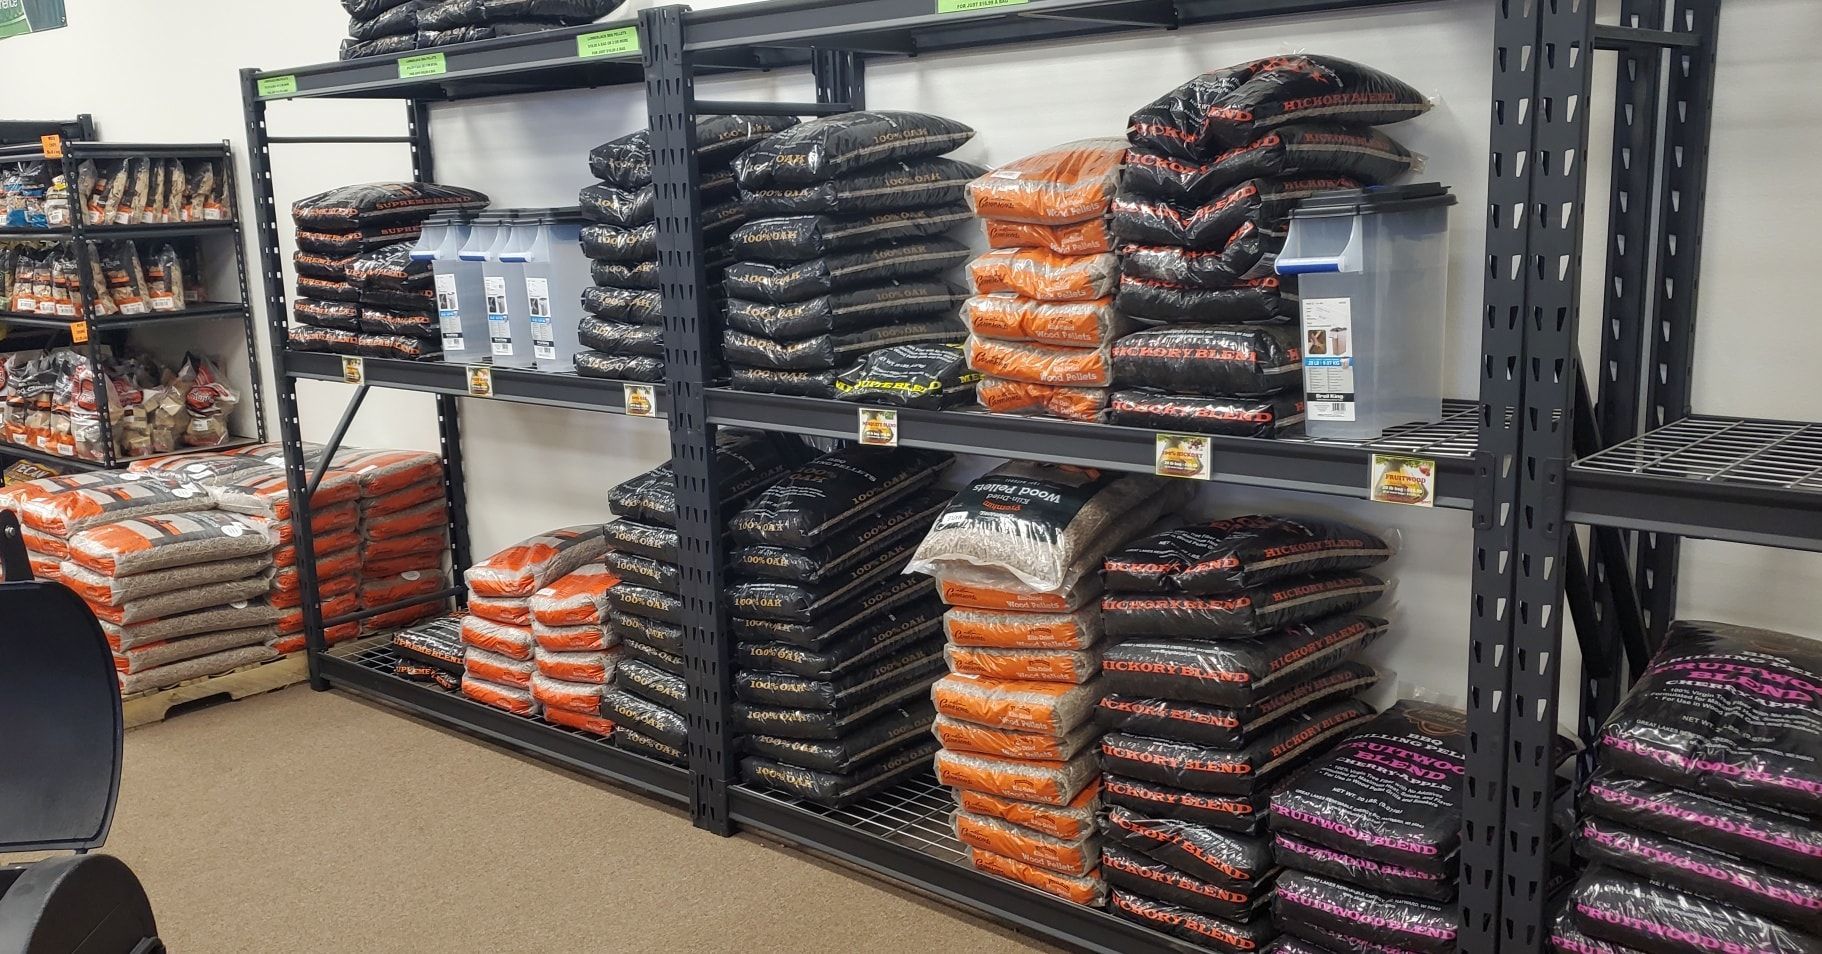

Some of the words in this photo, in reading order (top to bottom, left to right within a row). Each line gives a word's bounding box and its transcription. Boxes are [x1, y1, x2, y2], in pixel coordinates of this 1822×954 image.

[1282, 93, 1348, 111] HICKORY
[776, 154, 808, 166] OAK
[375, 197, 433, 211] SUPREME
[903, 288, 928, 297] OAK
[903, 325, 928, 334] OAK
[1066, 372, 1097, 381] Pellets
[834, 463, 878, 483] PELLETS
[1385, 474, 1426, 484] FRUITWOOD
[851, 487, 883, 505] 100%
[972, 483, 1018, 495] Pellets
[1018, 486, 1060, 504] Wood
[857, 525, 888, 543] 100%
[888, 508, 915, 526] OAK
[639, 537, 663, 549] OAK
[1263, 540, 1323, 559] HICKORY
[1323, 537, 1363, 550] BLEND
[765, 555, 788, 567] OAK
[639, 566, 662, 580] OAK
[862, 591, 891, 608] 100%
[891, 576, 917, 593] OAK
[1272, 583, 1322, 602] HICKORY
[620, 593, 646, 607] 100%
[646, 598, 670, 611] OAK
[760, 597, 783, 608] OAK
[1031, 601, 1060, 610] Pellets
[394, 637, 432, 656] UPREME
[750, 647, 777, 657] 100%
[1269, 640, 1326, 672] HICKORY
[1325, 621, 1367, 647] BLEND
[1741, 650, 1791, 663] BBQ
[396, 666, 432, 675] UPREME
[1102, 660, 1178, 675] HICKORY
[1181, 665, 1250, 684] BLEND
[1687, 671, 1814, 702] BLEND
[1692, 690, 1715, 699] Virgin
[1650, 691, 1693, 701] Formulated
[1694, 694, 1706, 702] for
[1676, 697, 1692, 705] Use
[1702, 702, 1724, 716] Wood
[614, 703, 640, 721] 100%
[640, 715, 666, 732] OAK
[1171, 709, 1240, 729] BLEND
[1636, 719, 1656, 728] GREAT
[1657, 724, 1679, 734] LAKES
[1682, 715, 1699, 724] NET
[1701, 719, 1714, 728] WT.
[1272, 722, 1323, 757] HICKORY
[1322, 709, 1358, 731] BLEND
[1352, 733, 1423, 748] RILLING
[1407, 733, 1444, 746] BBQ
[654, 743, 681, 758] OAK
[1102, 744, 1180, 769] HICKORY
[1185, 760, 1252, 775] BLEND
[1350, 741, 1465, 775] RUITWOO
[1336, 757, 1453, 792] CHERRY-APPLE
[1354, 750, 1446, 781] BLEND
[1104, 781, 1178, 804] HICKORY
[1180, 795, 1253, 814] BLEND
[1589, 783, 1736, 834] FRUITWOOD
[1270, 801, 1372, 843] FRUITWOOD
[1372, 836, 1438, 856] BLEND
[1021, 852, 1045, 865] Wood
[1181, 838, 1250, 881] BLEND
[1583, 827, 1729, 881] FRUITWOOD
[1102, 856, 1175, 885] HICKORY
[1178, 875, 1248, 904] BLEND
[1184, 918, 1256, 950] BLEND
[1386, 920, 1457, 941] BLEND
[1577, 904, 1721, 950] FRUITWOOD
